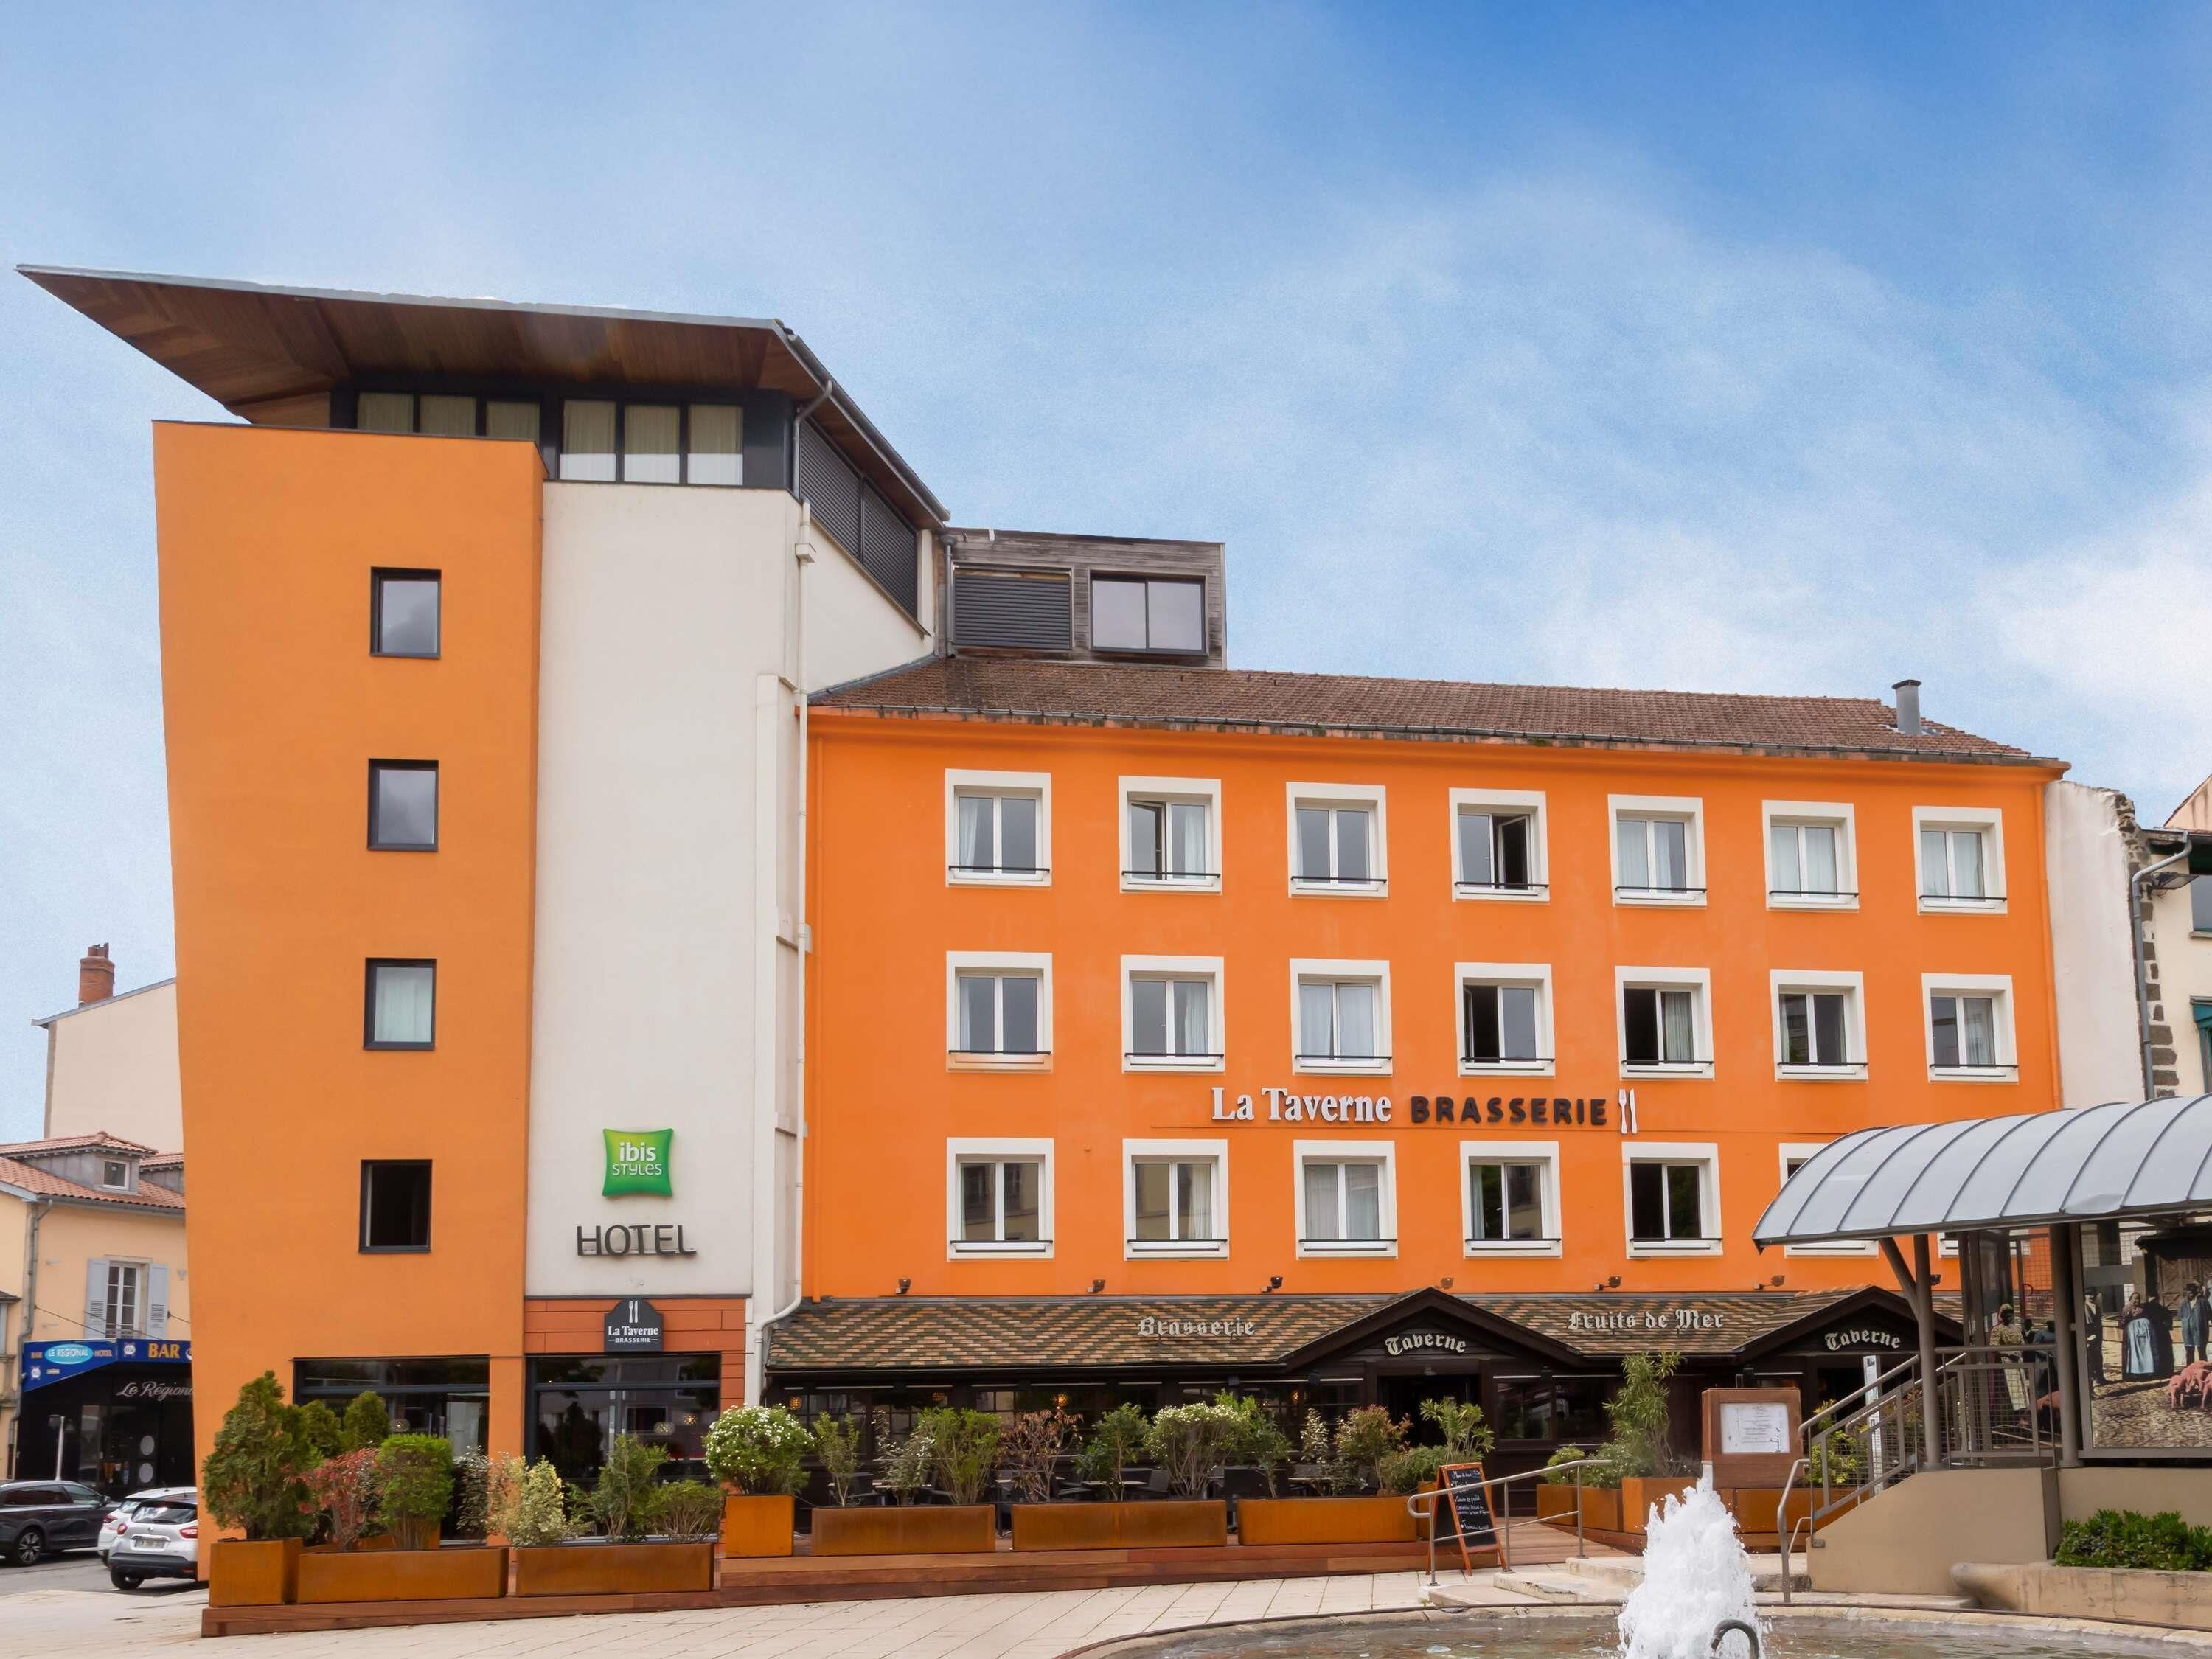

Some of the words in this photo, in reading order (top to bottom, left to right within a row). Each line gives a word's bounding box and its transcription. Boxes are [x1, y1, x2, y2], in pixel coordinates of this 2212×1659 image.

[1211, 1087, 1254, 1121] La
[1262, 1087, 1392, 1123] Taverne
[1411, 1096, 1607, 1125] BRASSERIE
[619, 1142, 656, 1162] ibis
[577, 1225, 697, 1256] HOTEL
[1138, 1316, 1255, 1336] Brasserie
[1568, 1311, 1636, 1330] Fruits
[1645, 1311, 1668, 1329] de
[1675, 1309, 1724, 1329] Mer
[608, 1326, 620, 1336] La
[622, 1326, 658, 1336] Taverne
[1825, 1329, 1900, 1351] Taverne
[48, 1349, 55, 1357] LE
[148, 1343, 181, 1359] BAR
[1385, 1333, 1467, 1356] Taverne
[116, 1382, 139, 1397] Le
